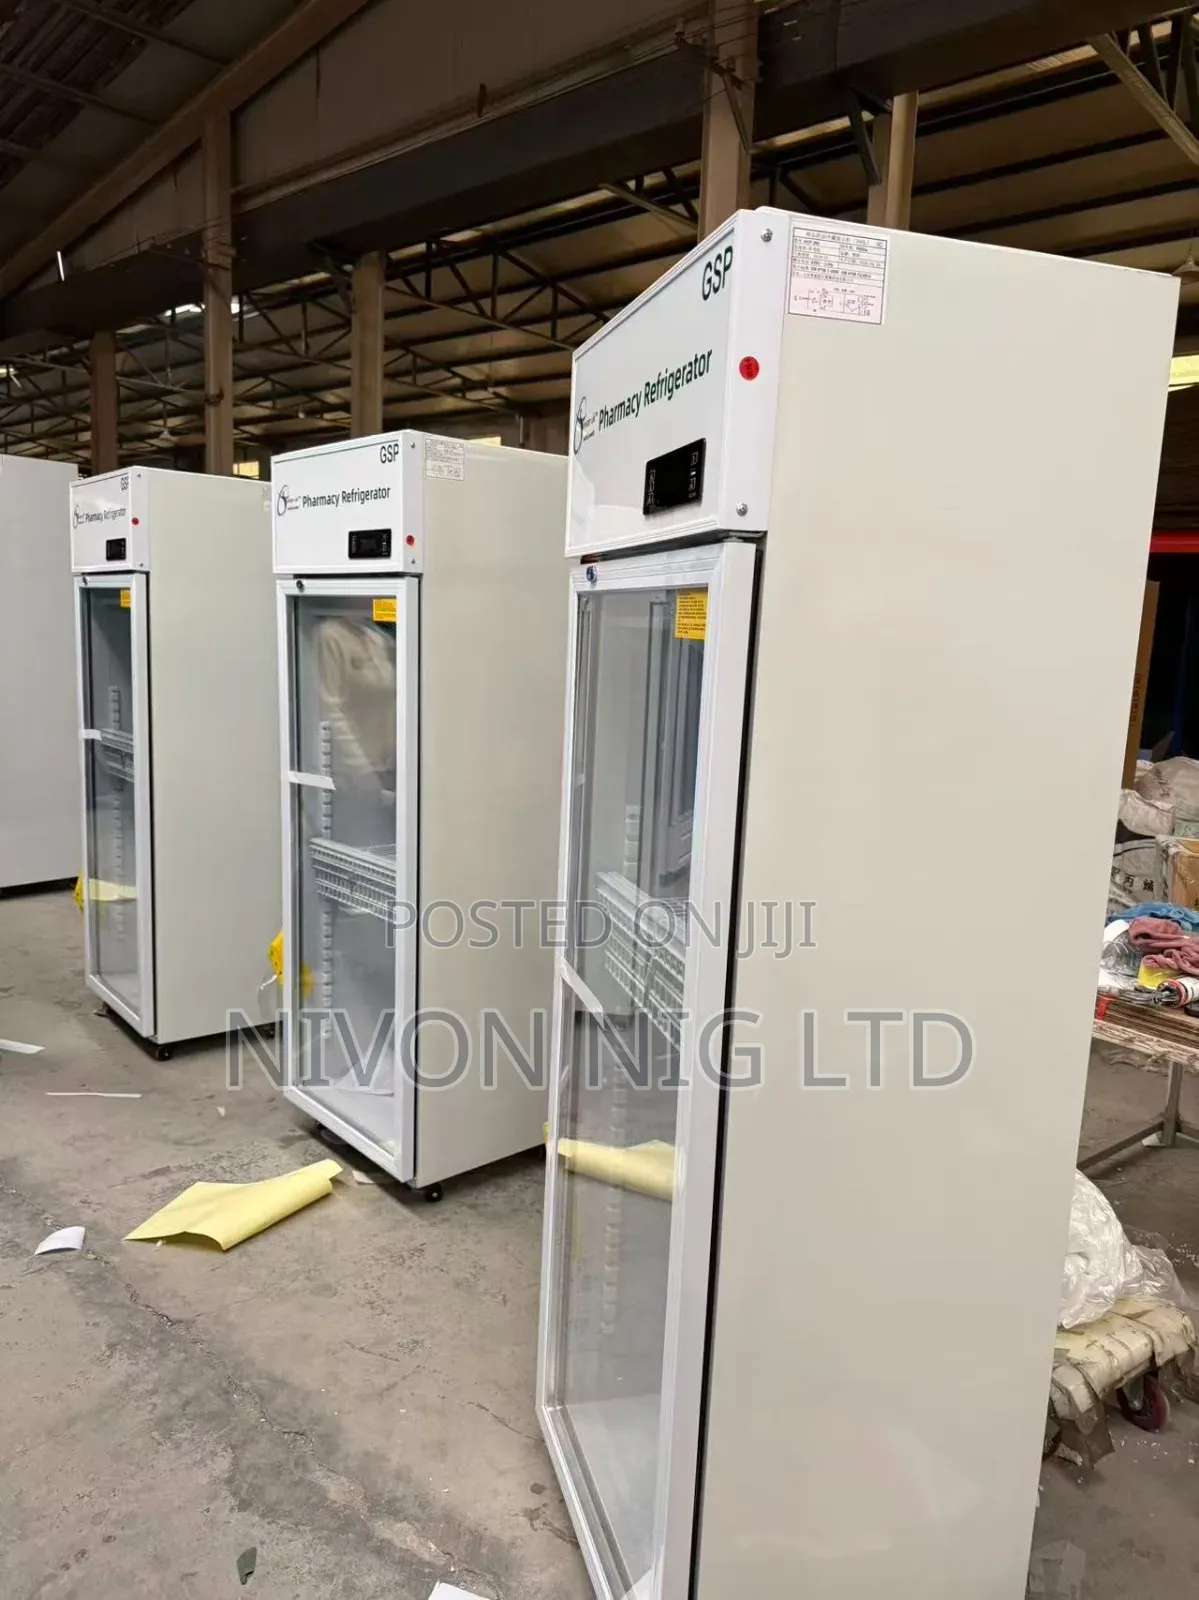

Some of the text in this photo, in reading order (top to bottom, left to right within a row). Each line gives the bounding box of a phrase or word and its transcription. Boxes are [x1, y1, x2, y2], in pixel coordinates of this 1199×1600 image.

[702, 245, 733, 301] GSP
[598, 349, 712, 432] Pharmacy Refrigerator
[380, 443, 399, 463] GSP
[302, 487, 391, 508] Pharmacy Refrigerator
